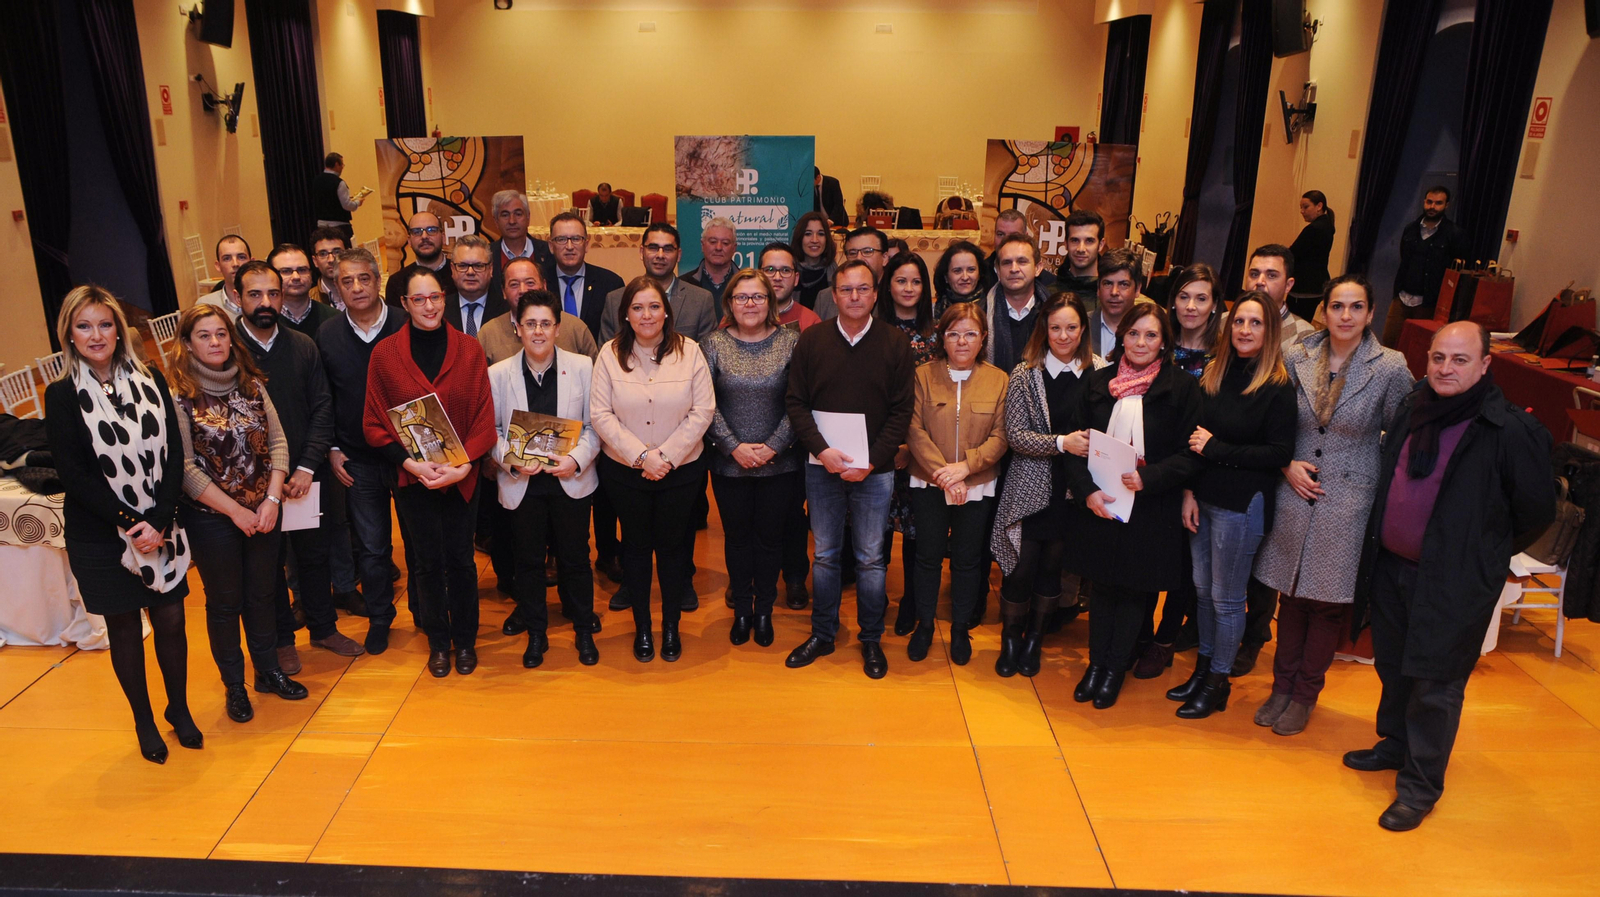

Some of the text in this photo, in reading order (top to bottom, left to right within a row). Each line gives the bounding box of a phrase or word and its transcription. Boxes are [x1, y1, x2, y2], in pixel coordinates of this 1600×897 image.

[704, 196, 786, 204] CLUB PATRIMONIO
[729, 208, 774, 225] atural
[732, 251, 755, 269] 01
